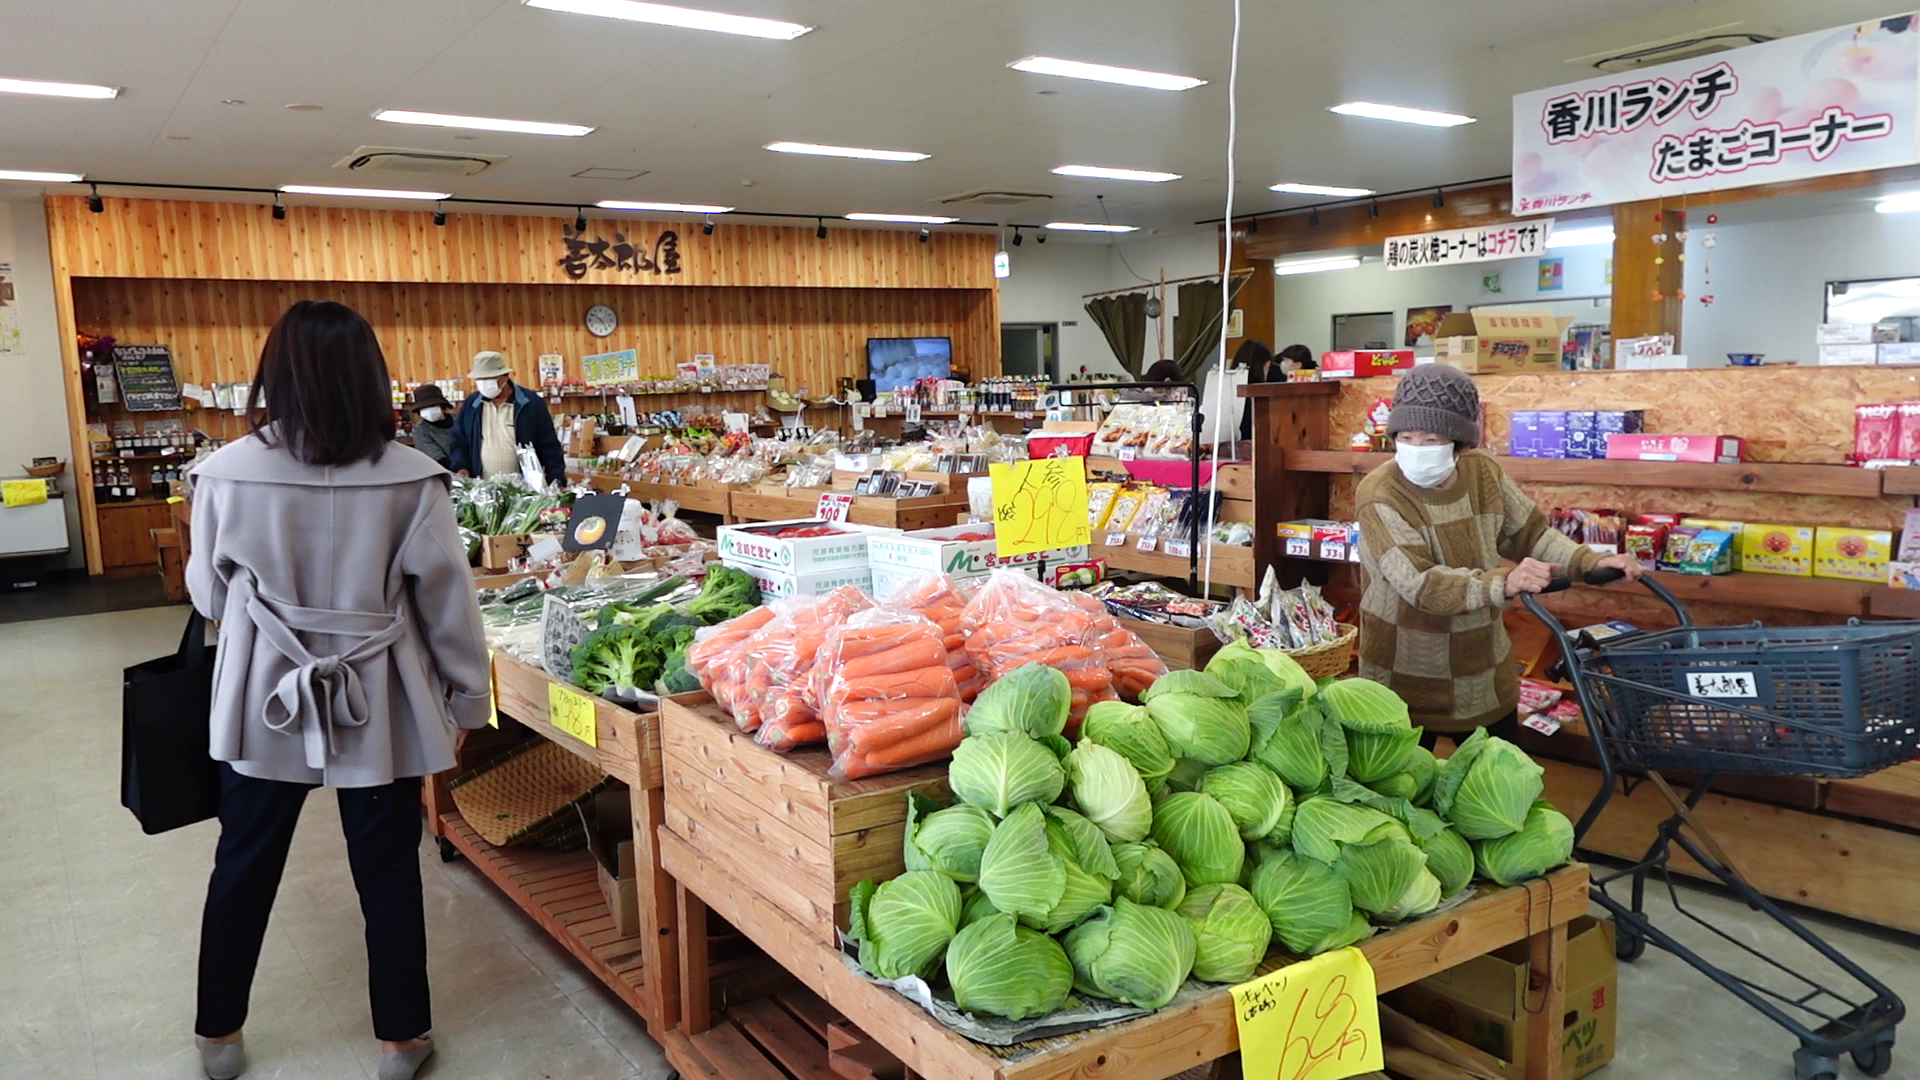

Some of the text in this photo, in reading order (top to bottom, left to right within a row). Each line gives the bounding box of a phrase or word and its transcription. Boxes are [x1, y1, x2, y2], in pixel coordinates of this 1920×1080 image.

[1546, 66, 1734, 140] 香川ランチ
[1655, 114, 1887, 177] たまごコーナー
[736, 541, 772, 560] 宮崎とまと
[1562, 1018, 1597, 1054] ベツ
